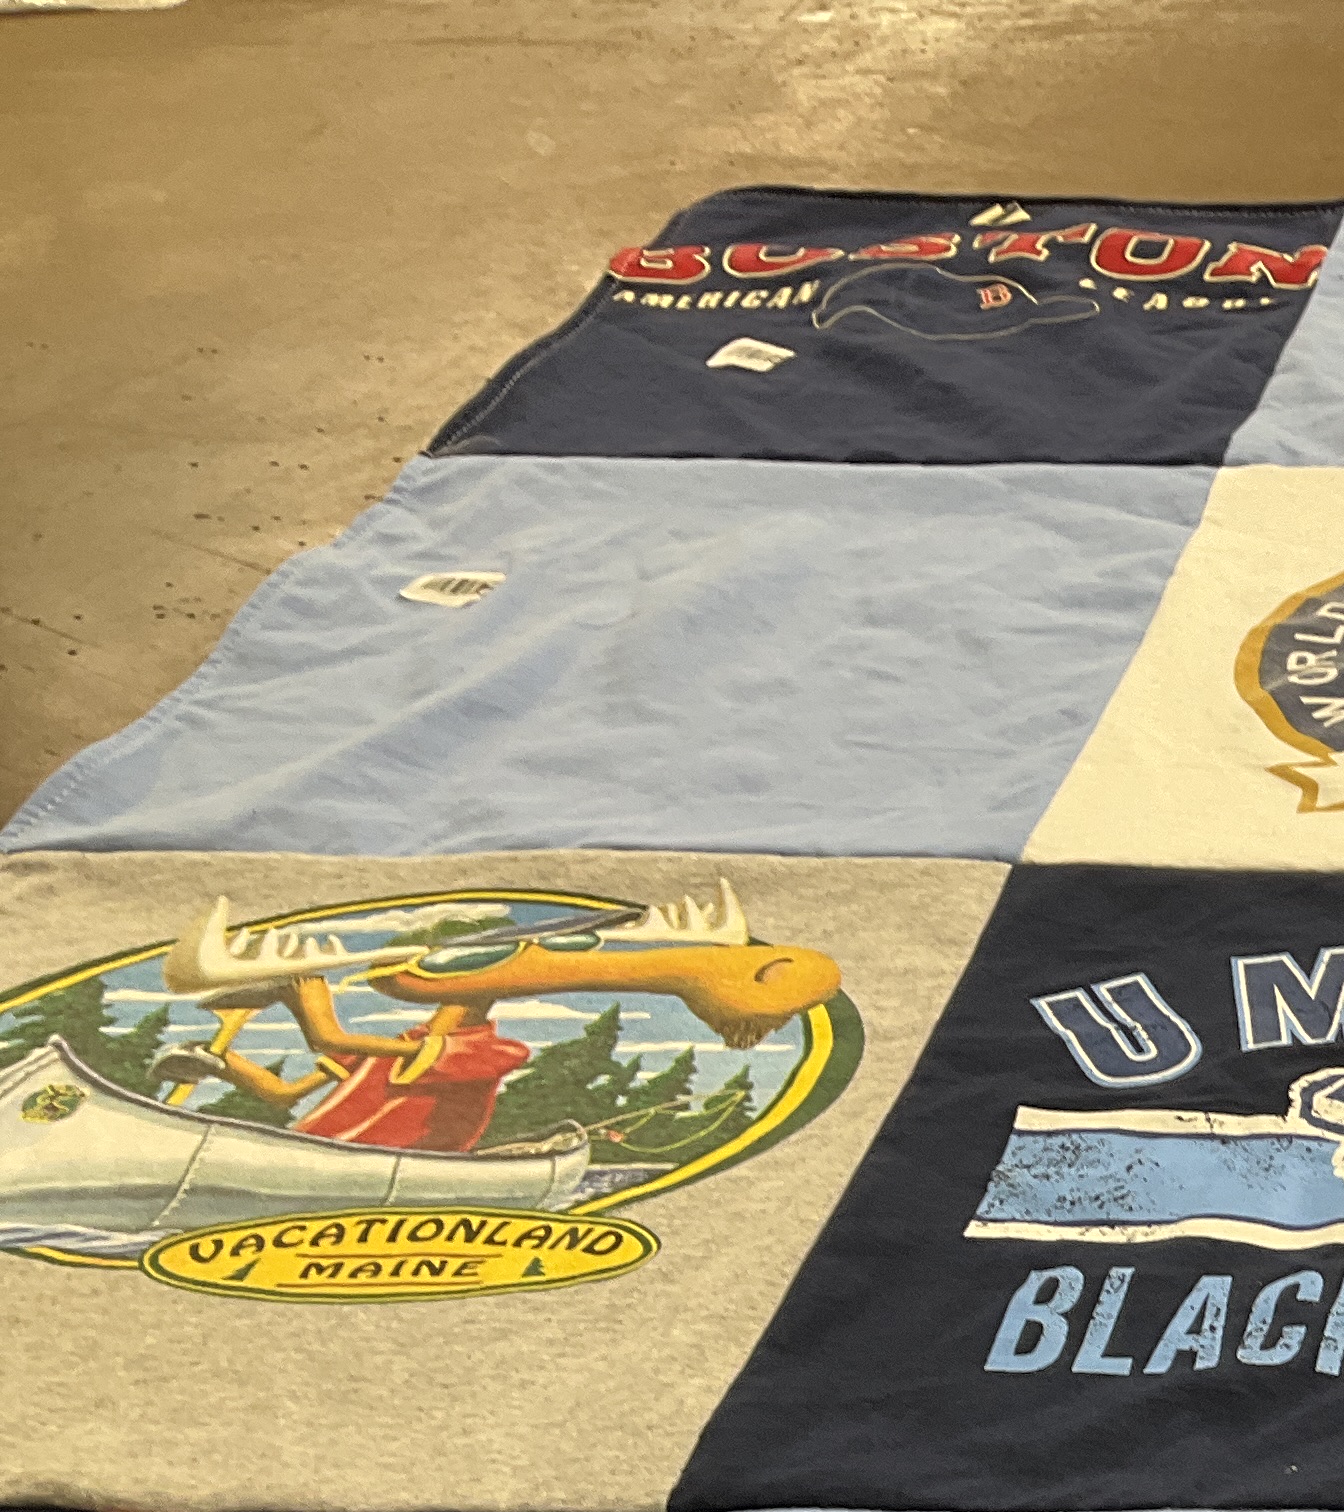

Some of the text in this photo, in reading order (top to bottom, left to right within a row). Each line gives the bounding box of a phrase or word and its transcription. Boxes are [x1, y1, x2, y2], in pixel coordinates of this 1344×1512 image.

[608, 222, 1328, 290] BOSTON
[613, 279, 821, 310] AMERICAN
[186, 1217, 627, 1266] VACATIONLAND
[298, 1258, 489, 1282] MAINE
